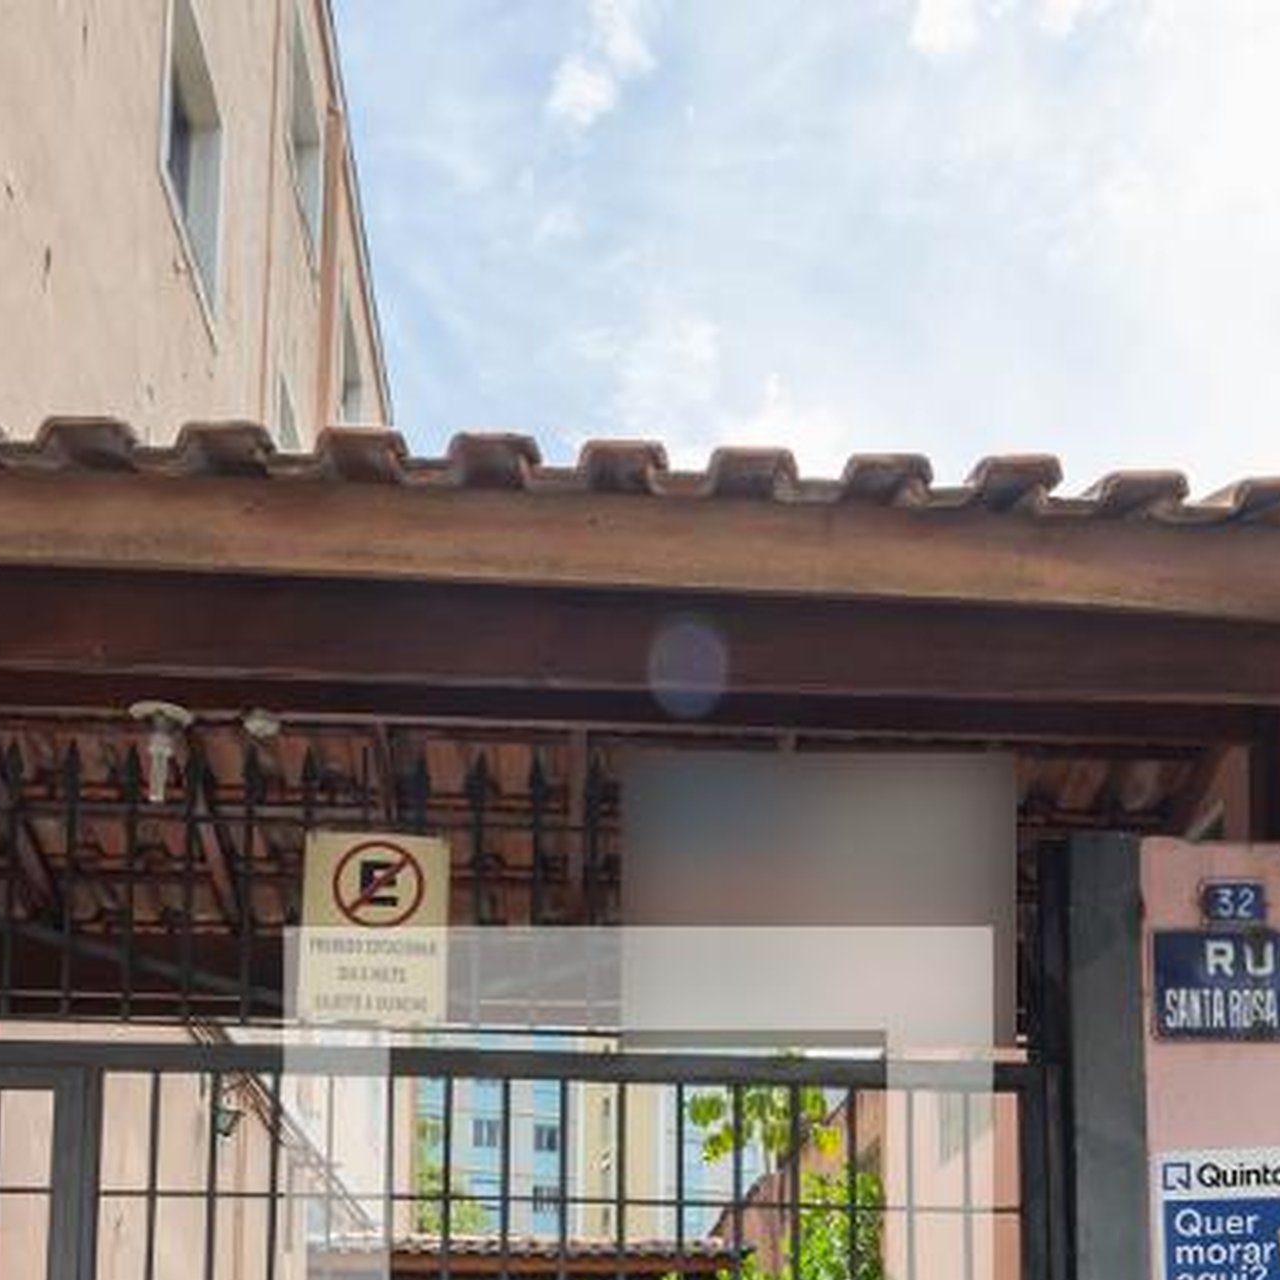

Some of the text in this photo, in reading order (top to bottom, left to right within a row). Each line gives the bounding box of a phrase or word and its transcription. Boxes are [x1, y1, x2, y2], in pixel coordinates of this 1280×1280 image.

[1217, 888, 1255, 917] 32
[1165, 988, 1226, 1028] SANTA
[1174, 1208, 1260, 1237] Quer
[1175, 1241, 1276, 1265] morar
